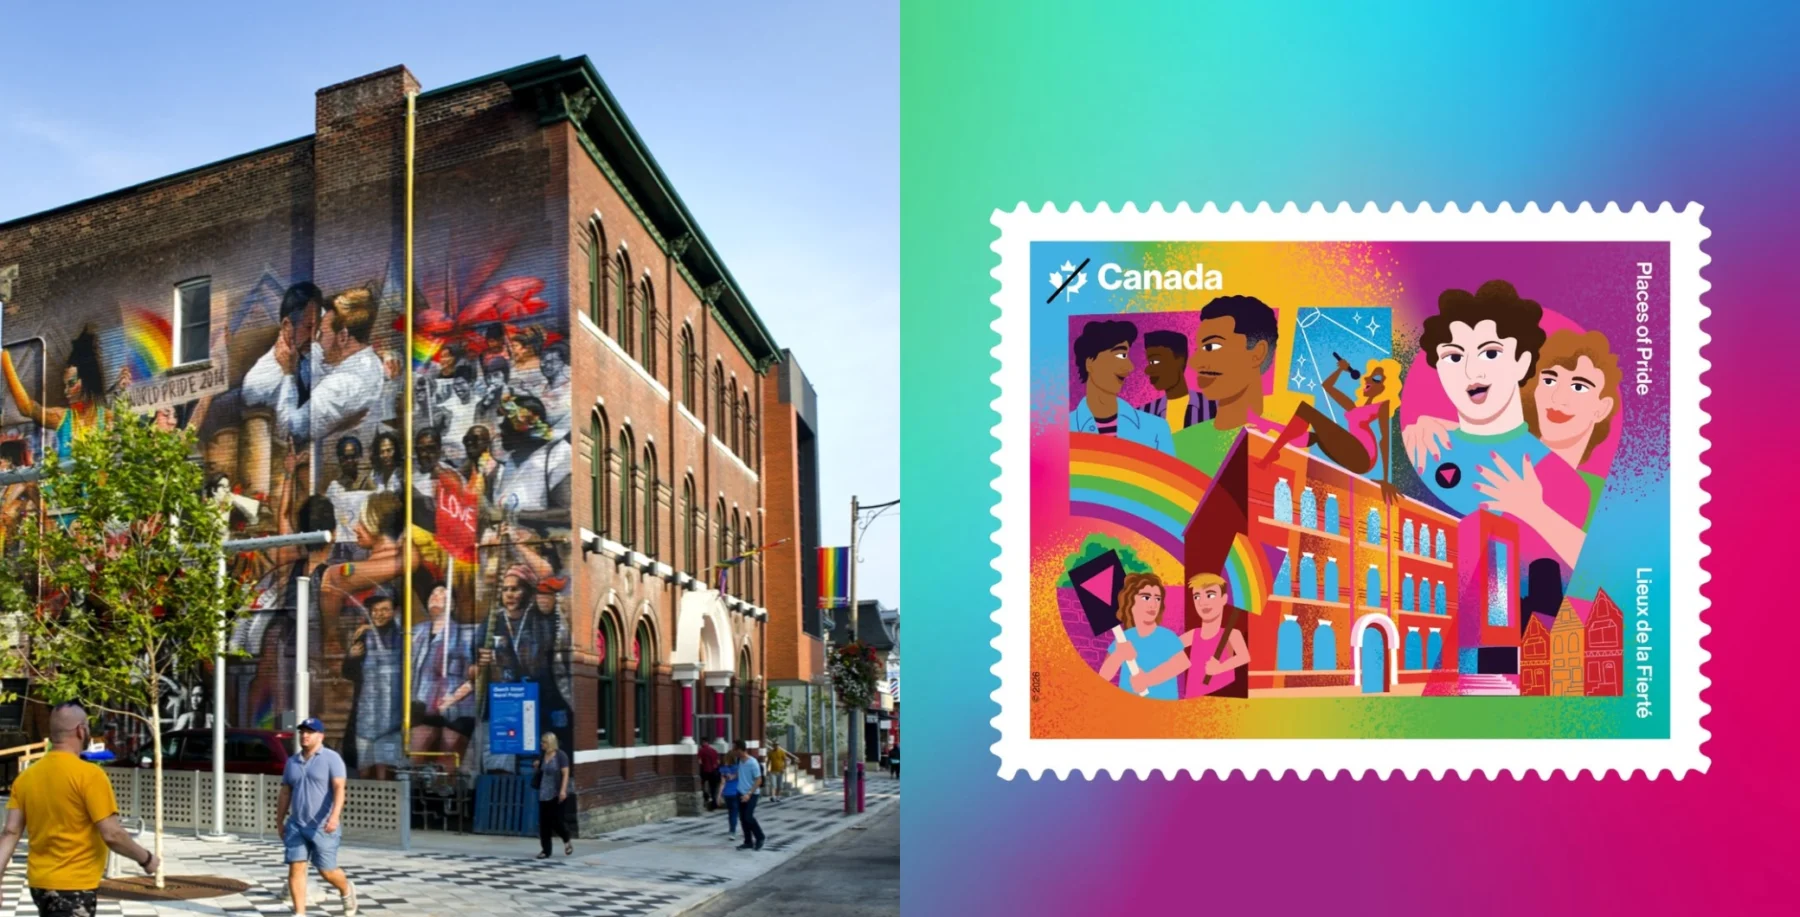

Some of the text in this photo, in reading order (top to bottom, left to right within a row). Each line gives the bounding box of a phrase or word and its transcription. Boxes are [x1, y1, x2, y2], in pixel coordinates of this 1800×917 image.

[1097, 263, 1223, 291] Canada
[1636, 262, 1652, 396] Places of Pride
[161, 376, 196, 401] PRIDE
[199, 370, 225, 390] 2014
[440, 487, 476, 533] LOVE
[1636, 568, 1652, 719] Lieux de la Fierté
[1032, 672, 1040, 693] 2026
